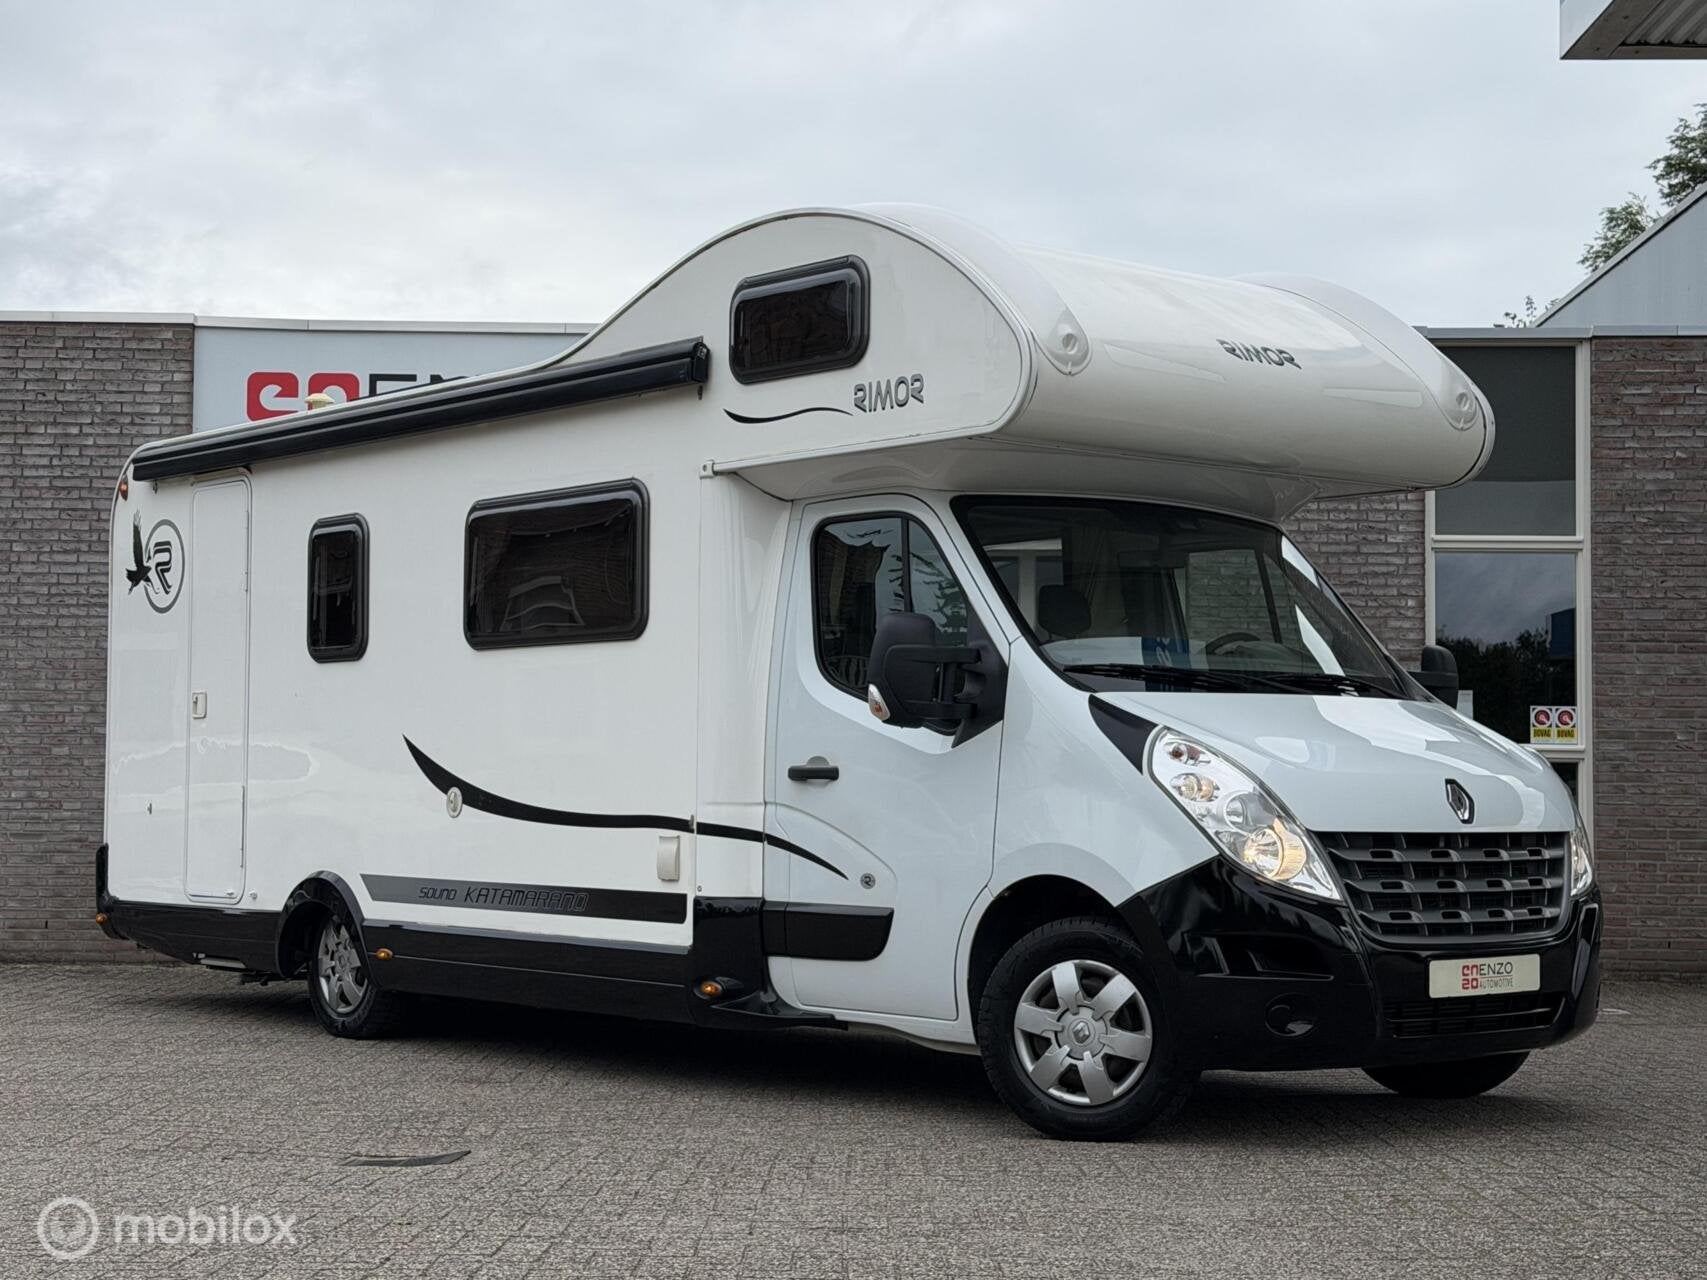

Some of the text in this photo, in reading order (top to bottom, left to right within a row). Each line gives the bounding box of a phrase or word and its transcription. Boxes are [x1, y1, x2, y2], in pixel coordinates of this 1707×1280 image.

[1215, 338, 1302, 370] RIMOR
[853, 373, 924, 413] RIMOR
[1479, 962, 1514, 976] ENZO
[1479, 978, 1514, 989] AUTOMOTIVE
